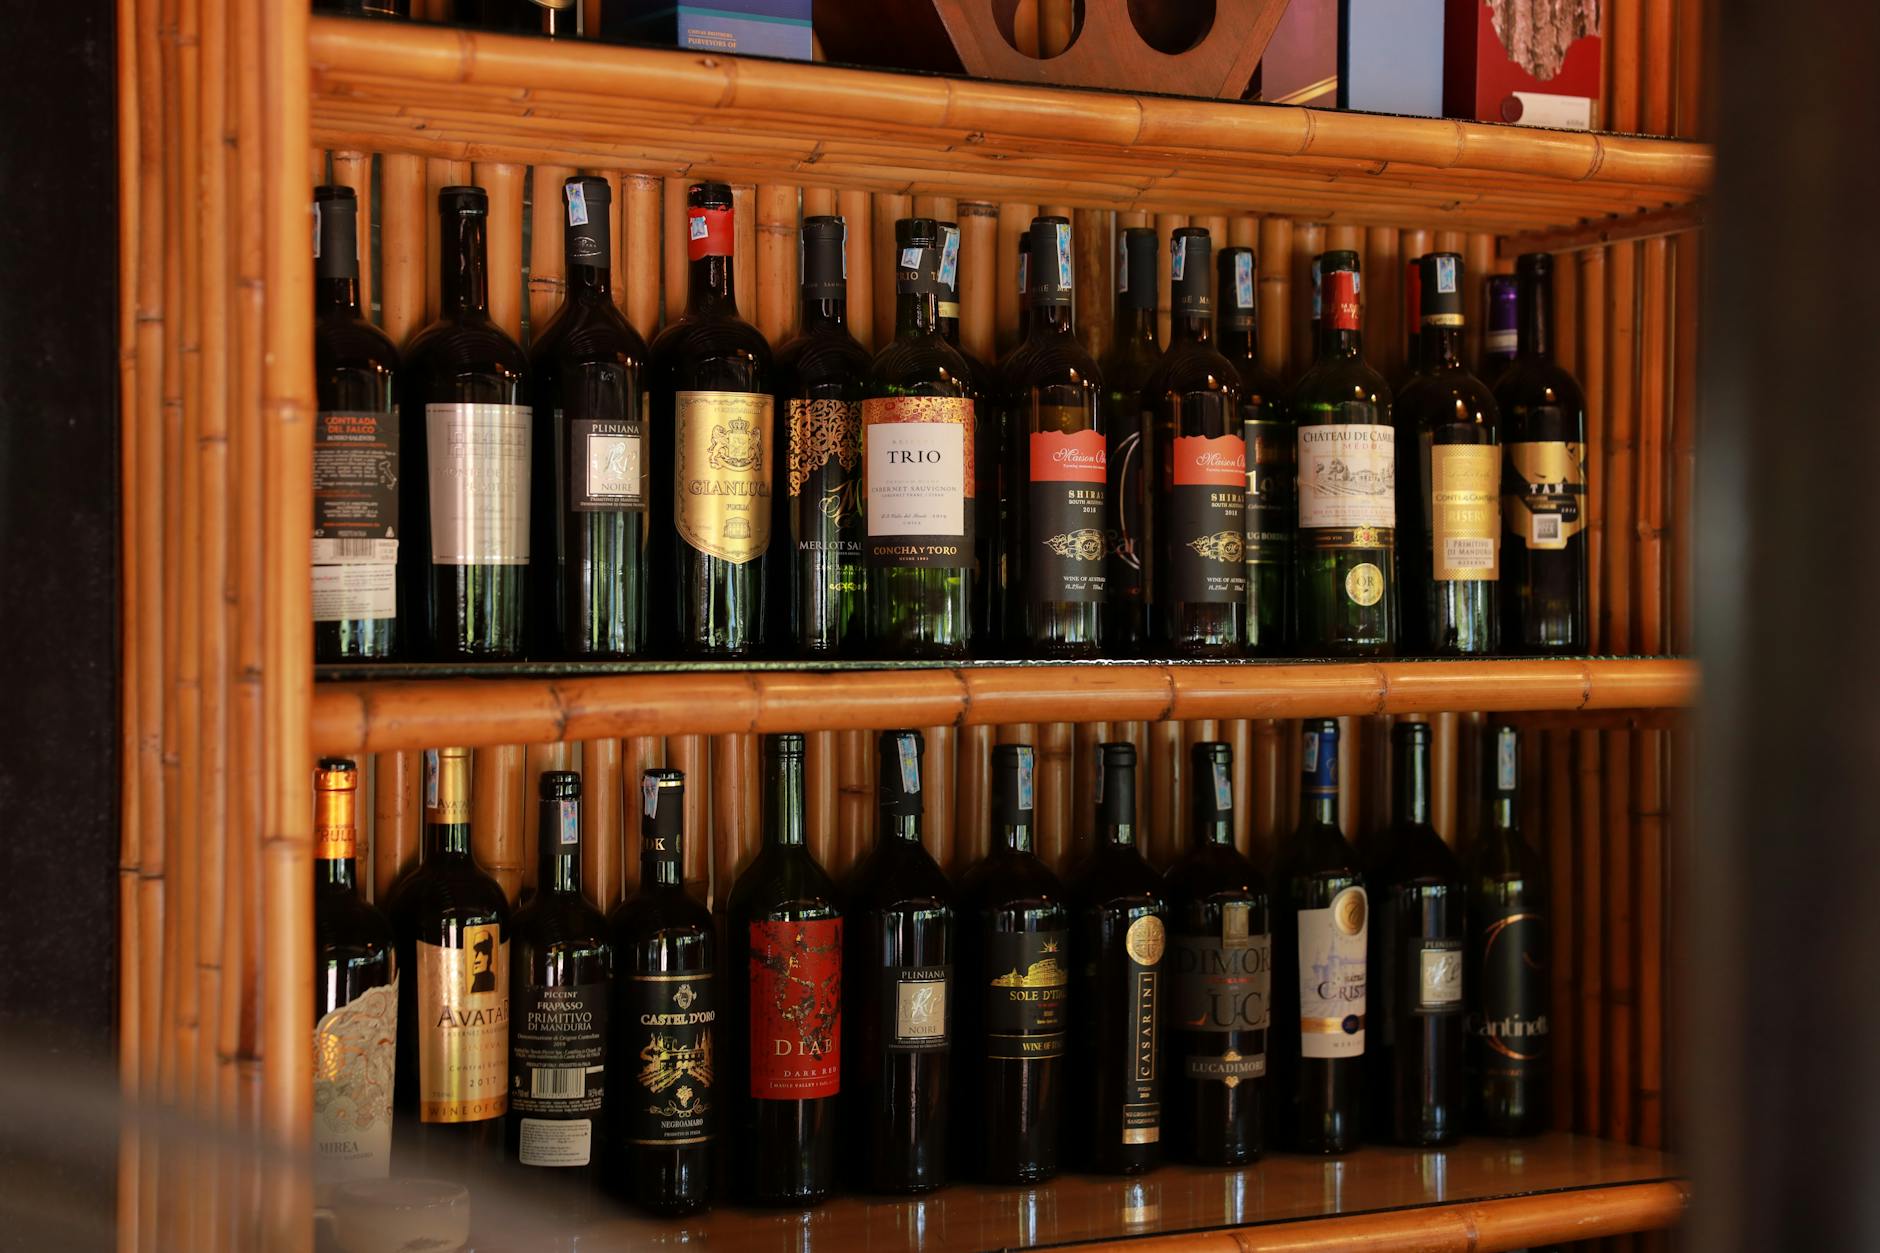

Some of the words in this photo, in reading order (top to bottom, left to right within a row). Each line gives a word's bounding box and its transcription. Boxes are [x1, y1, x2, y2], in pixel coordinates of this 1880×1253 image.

[688, 37, 726, 48] PURVEYORS
[897, 271, 919, 281] RIO
[324, 417, 377, 425] CONTRADA
[328, 425, 344, 433] DEL
[346, 425, 375, 434] FALCO
[592, 424, 639, 434] PLINIANA
[1303, 430, 1351, 443] CHÂTEAU
[1354, 431, 1368, 442] DE
[887, 450, 941, 464] TRIO
[1053, 448, 1095, 464] Maison
[1196, 452, 1236, 467] Maison
[601, 482, 632, 491] NOIRE
[800, 541, 846, 551] MERLOT
[873, 546, 917, 555] CONCHA
[919, 546, 925, 554] Y
[926, 546, 957, 555] TORO
[1356, 576, 1375, 587] OR
[901, 970, 945, 979] PLINIANA
[1009, 990, 1039, 1001] SOLE
[537, 1001, 584, 1011] FRAPASSO
[528, 1011, 592, 1023] PRIMITIVO
[640, 1013, 688, 1026] CASTEL
[688, 1010, 716, 1024] D'ORO
[528, 1022, 538, 1031] DI
[540, 1022, 592, 1031] MANDURIA
[1140, 976, 1153, 1076] CASARINI
[784, 1070, 817, 1078] DARK
[822, 1066, 838, 1075] RED
[469, 1076, 498, 1088] 2017
[428, 1102, 469, 1116] WINE
[661, 1118, 704, 1129] NEGROAMARO
